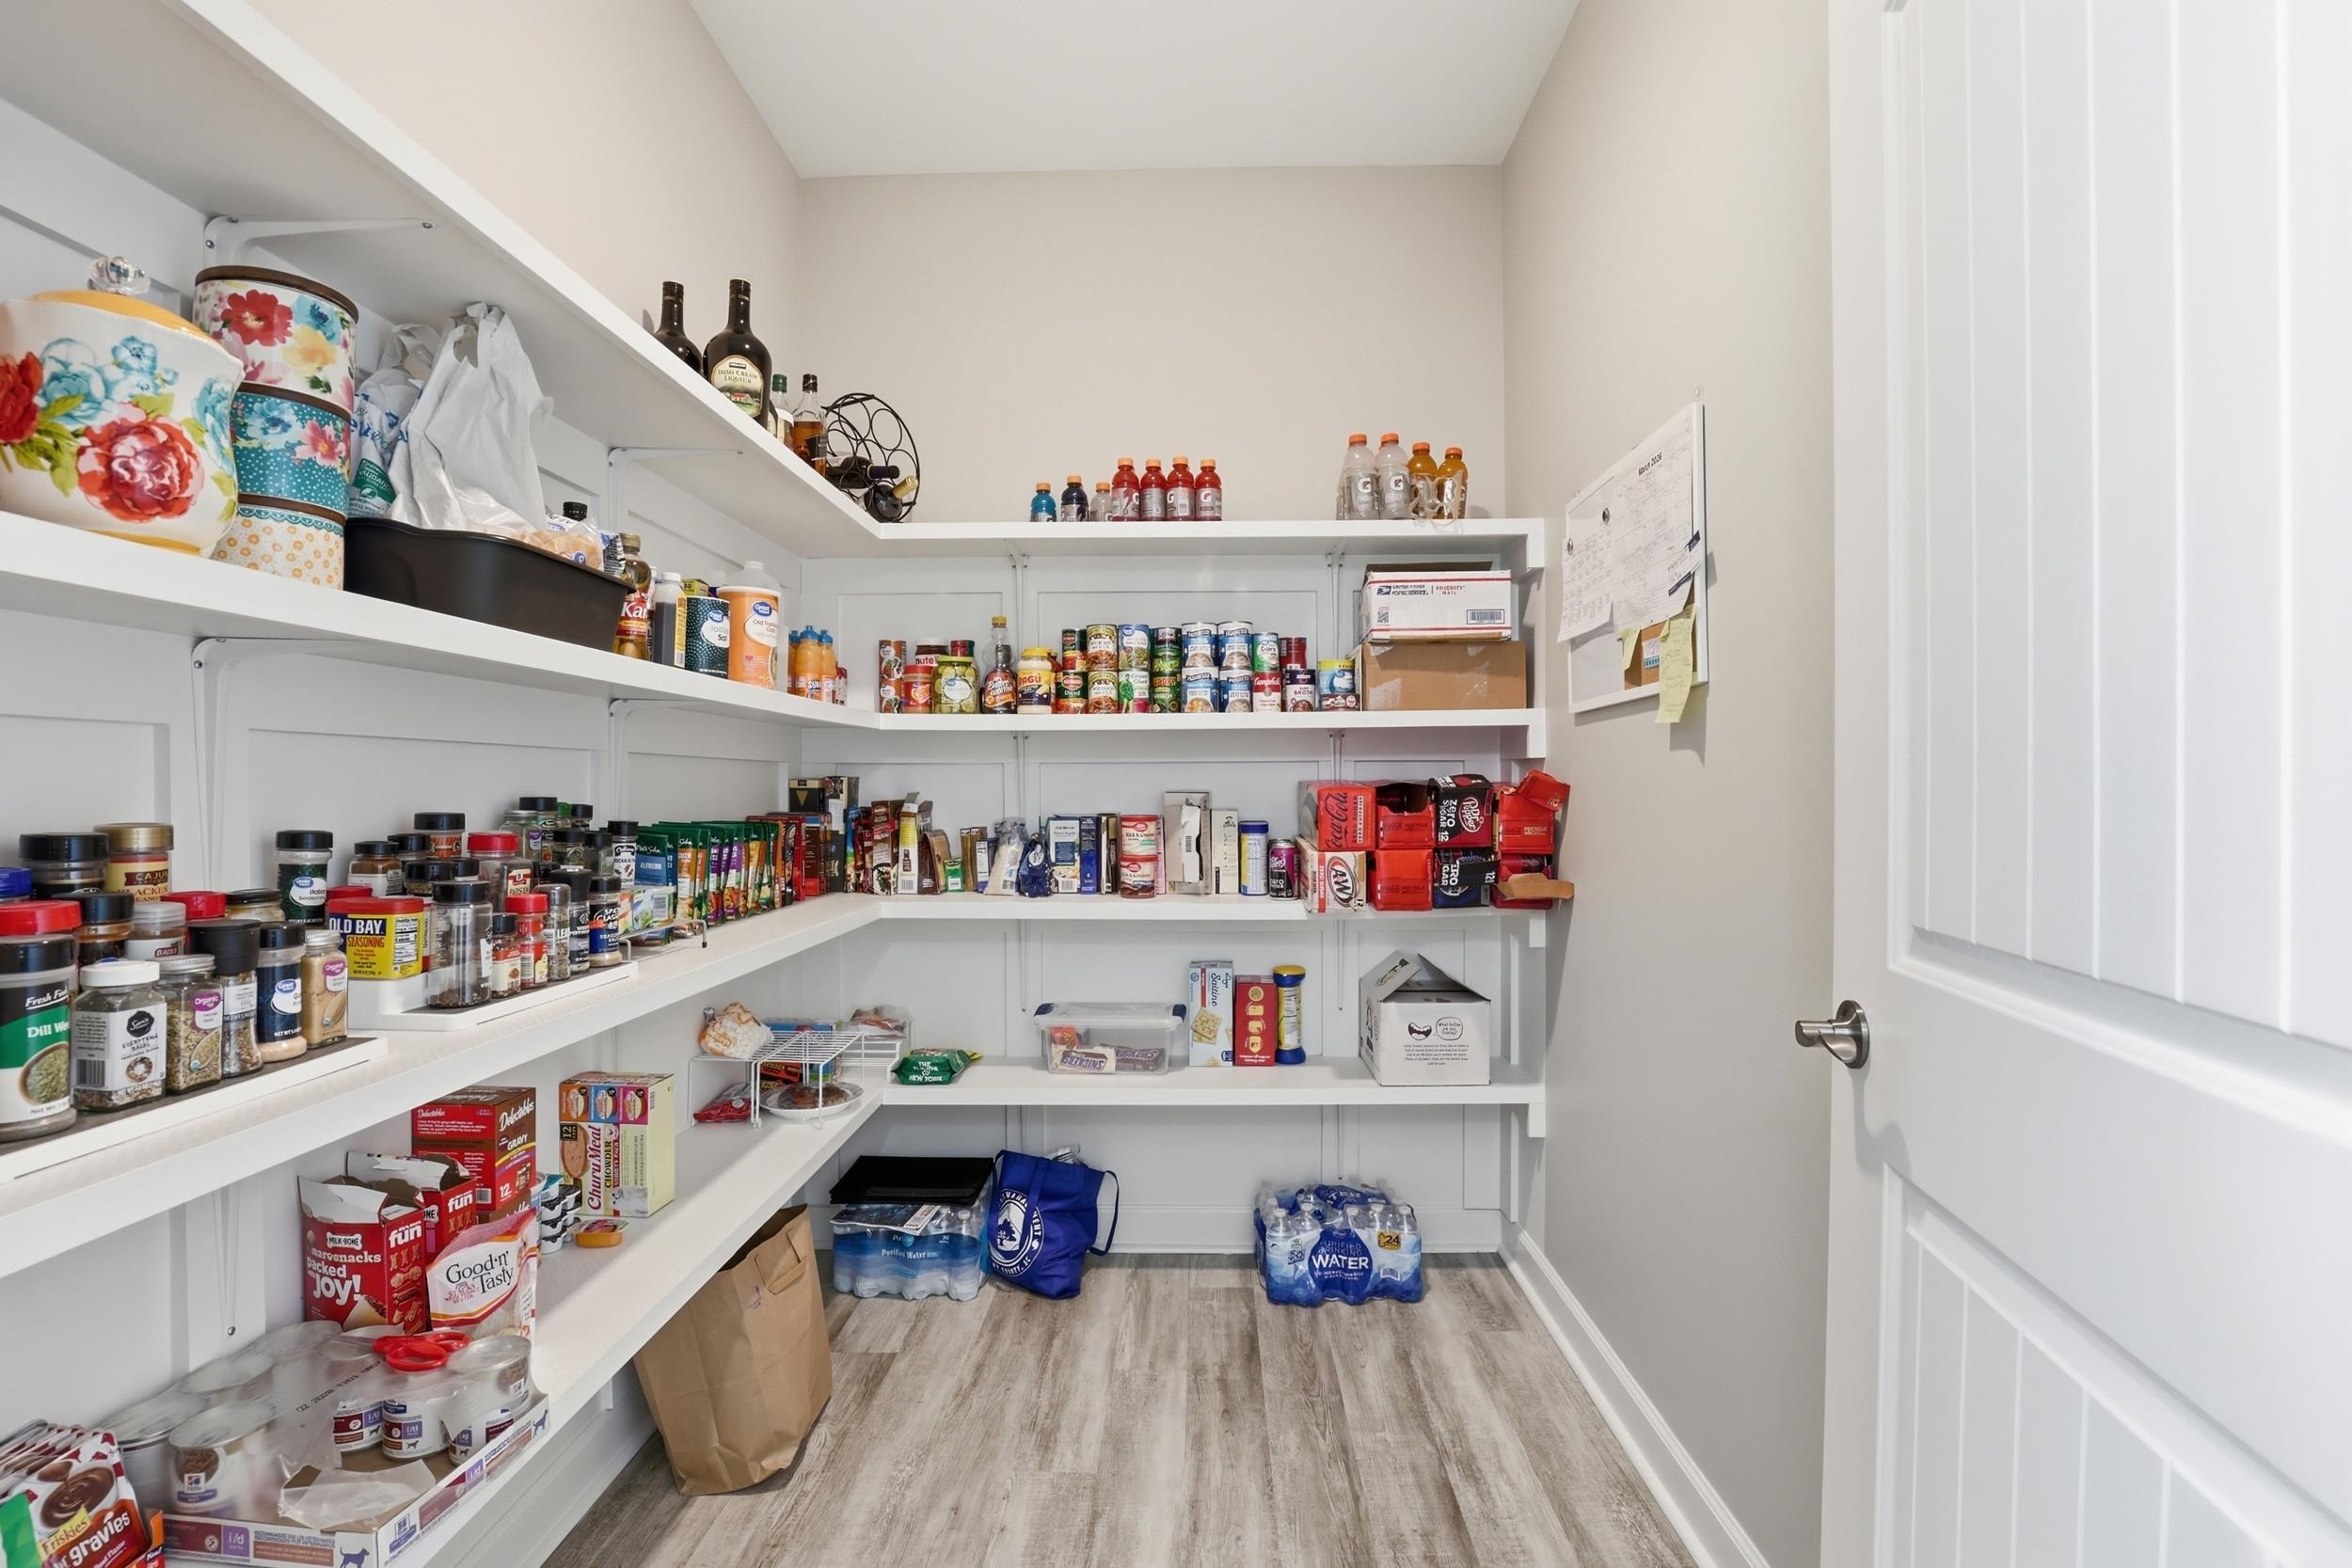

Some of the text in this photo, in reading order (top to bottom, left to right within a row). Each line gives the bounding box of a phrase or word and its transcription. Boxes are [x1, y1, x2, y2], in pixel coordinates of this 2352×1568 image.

[1325, 791, 1348, 848] Coca-Cola
[135, 870, 168, 882] CAJU
[329, 916, 382, 934] OLD BAY
[347, 936, 385, 948] SEASONING
[1211, 973, 1221, 1007] Saltine
[25, 992, 52, 1008] Fresh
[26, 1024, 52, 1038] Dill
[1062, 1054, 1105, 1070] SNICKERS
[499, 1097, 535, 1132] Delectables
[507, 1133, 529, 1151] GRAVY
[587, 1124, 602, 1211] Churu Meal
[604, 1140, 612, 1188] CHOWDER
[499, 1182, 511, 1199] 12
[1385, 1234, 1400, 1244] 24
[307, 1257, 347, 1278] packed
[1311, 1254, 1370, 1270] WATER
[471, 1266, 515, 1295] Tasty
[41, 1516, 89, 1554] Friskies
[69, 1511, 132, 1568] gravies
